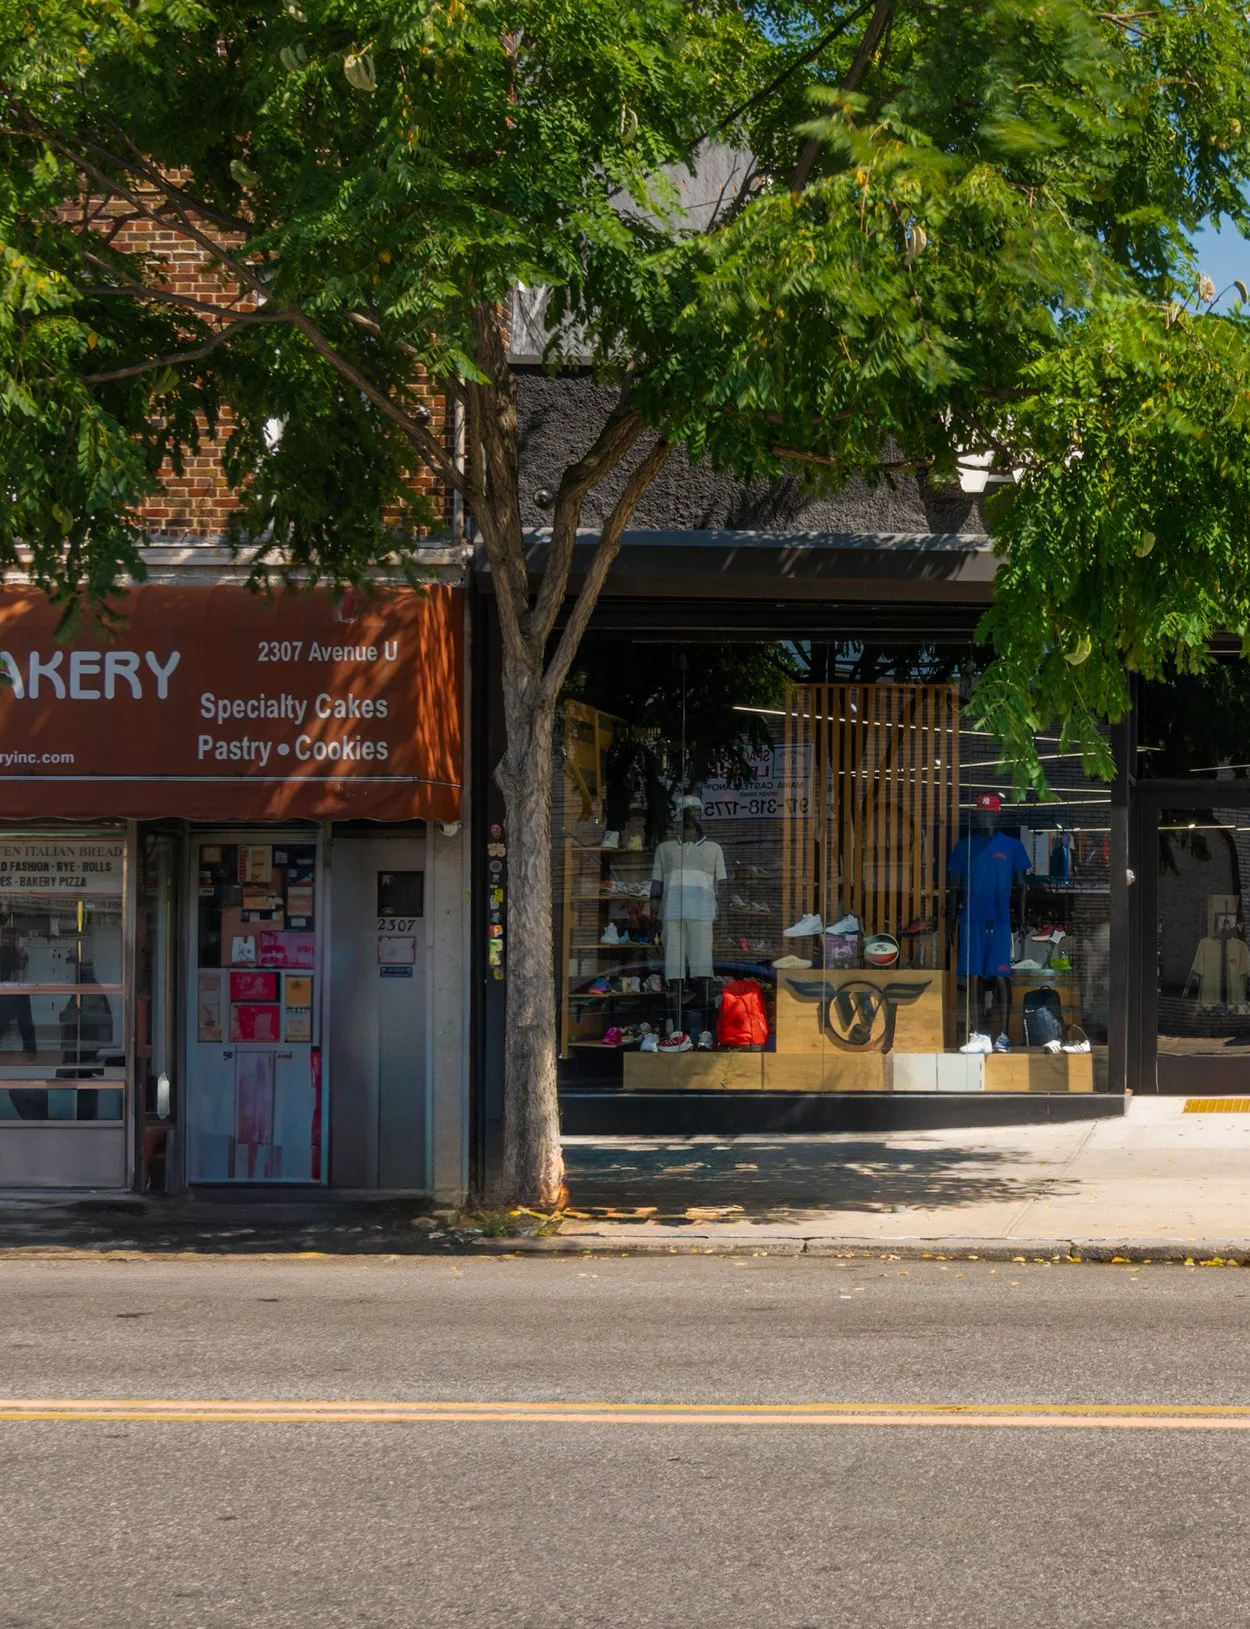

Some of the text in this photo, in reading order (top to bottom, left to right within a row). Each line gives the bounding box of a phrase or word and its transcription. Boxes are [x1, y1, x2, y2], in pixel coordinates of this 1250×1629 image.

[258, 641, 398, 663] 2307 Avenue U
[200, 692, 388, 725] Specialty Cakes
[198, 734, 389, 767] Pastry Cookies
[25, 846, 76, 857] ITALIAN
[79, 846, 122, 857] BREAD
[10, 861, 50, 873] FASHION
[56, 861, 76, 873] RYE
[82, 861, 112, 873] ROLLS
[19, 876, 57, 888] BAKERY
[58, 876, 87, 888] PIZZA
[377, 918, 417, 932] 2307
